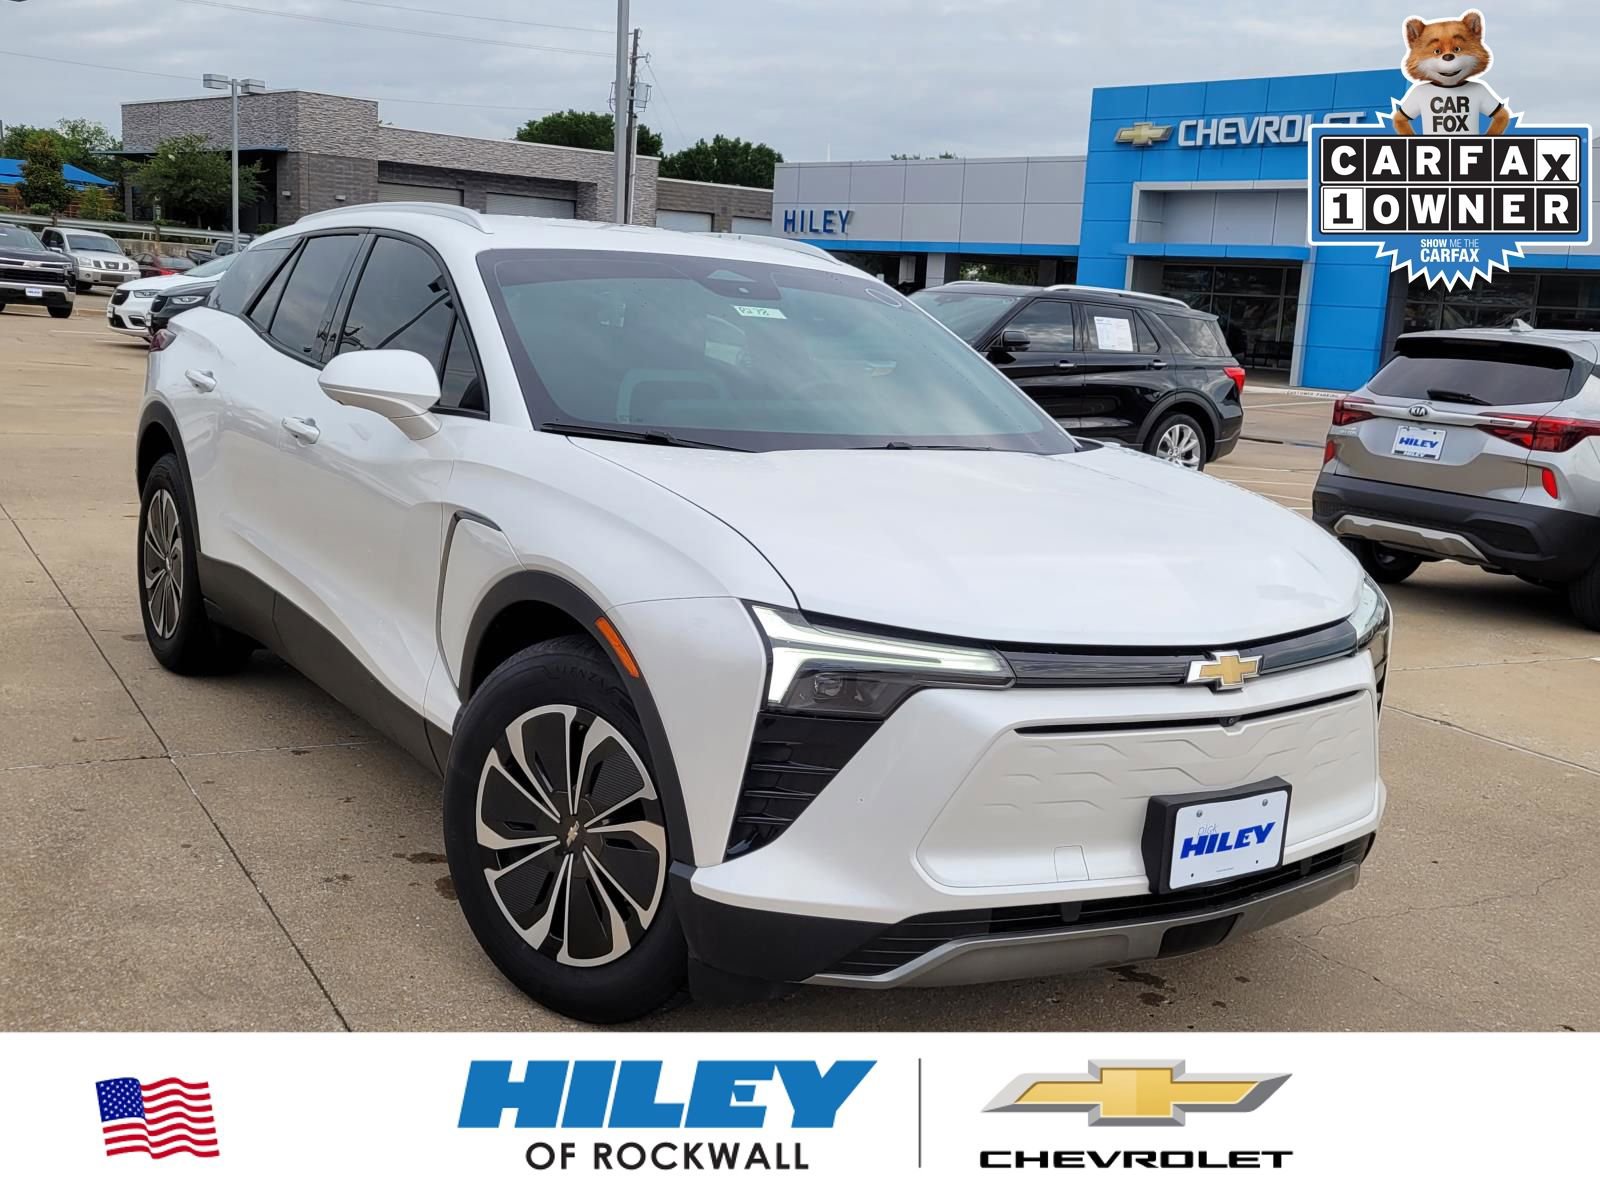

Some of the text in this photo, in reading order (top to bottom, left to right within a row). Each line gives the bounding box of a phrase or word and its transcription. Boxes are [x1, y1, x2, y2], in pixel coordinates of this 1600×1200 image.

[783, 209, 851, 234] HILEY
[1410, 407, 1426, 416] KIA
[1399, 437, 1439, 448] HILEY
[1180, 822, 1275, 859] HILEY
